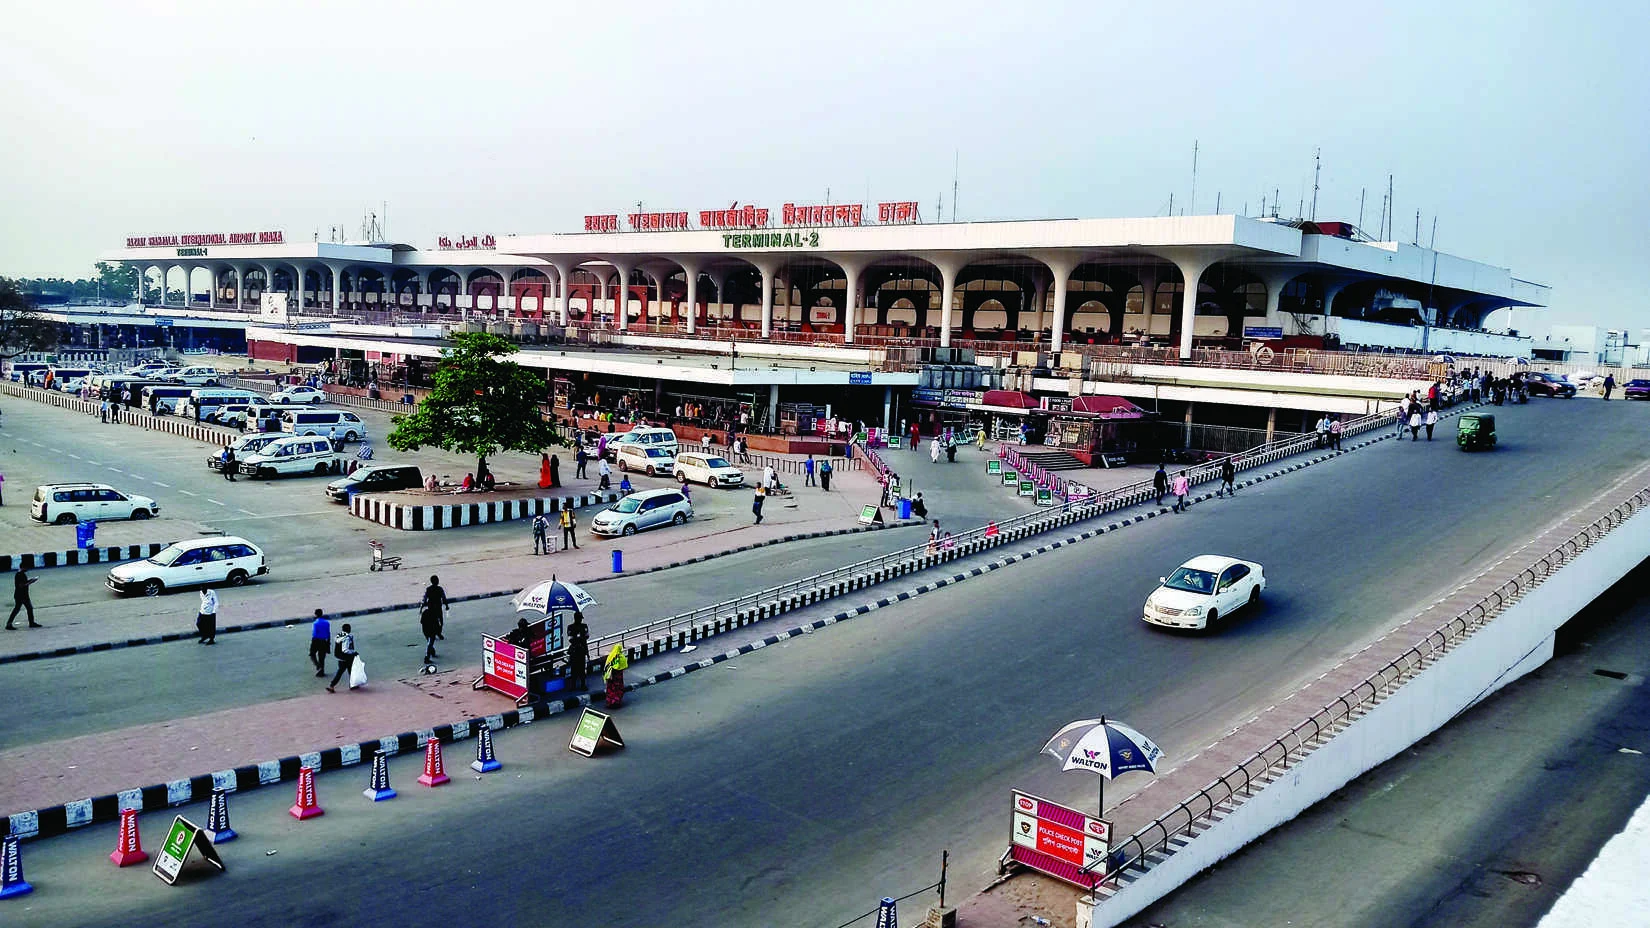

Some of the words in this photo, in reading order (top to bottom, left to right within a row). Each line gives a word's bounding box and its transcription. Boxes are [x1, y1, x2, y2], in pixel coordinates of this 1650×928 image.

[878, 202, 918, 221] ঢাকা
[181, 233, 226, 245] INTERNATIONAL
[229, 232, 256, 243] AIRPORT
[259, 231, 283, 242] DHAKA
[722, 232, 819, 248] TERMINAL-2
[484, 729, 492, 760] WALTON
[1071, 756, 1108, 770] WALTON
[305, 772, 313, 806] WALTON
[209, 794, 217, 829] WALTON
[218, 793, 226, 829] WALTON
[1019, 799, 1032, 809] STOP
[127, 814, 136, 852] WALTON
[1039, 826, 1055, 837] POLICE
[1055, 831, 1071, 843] CHECK
[1070, 836, 1083, 846] POST
[8, 841, 17, 881] WALTON
